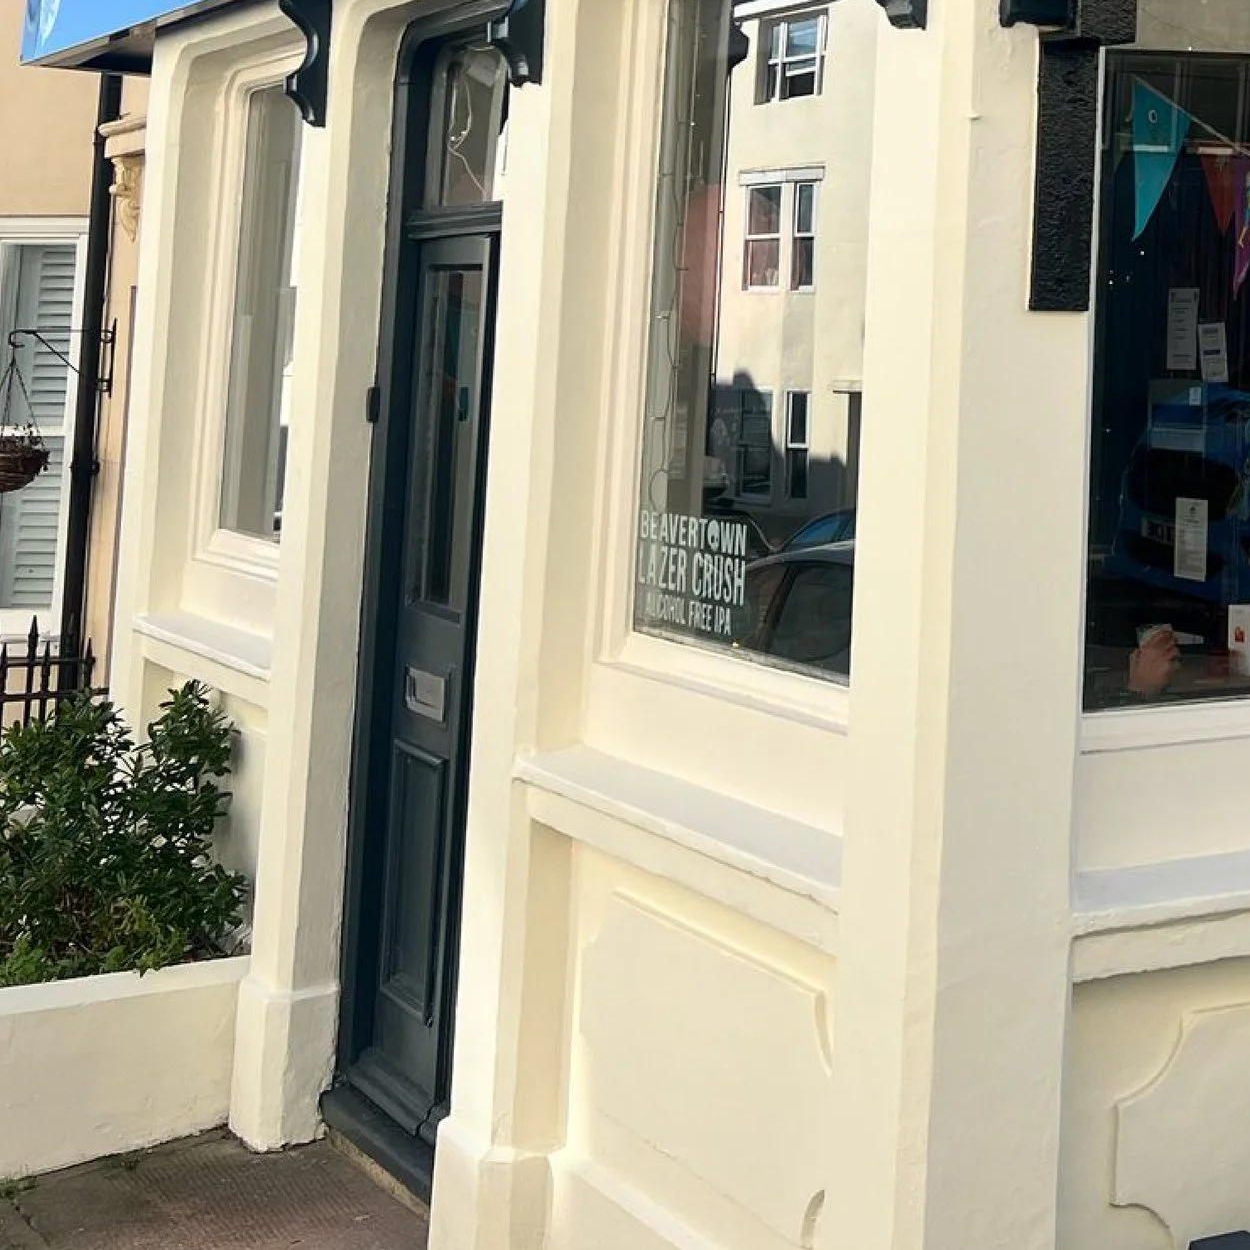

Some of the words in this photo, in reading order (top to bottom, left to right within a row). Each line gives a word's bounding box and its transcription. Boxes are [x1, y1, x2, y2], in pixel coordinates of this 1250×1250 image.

[639, 510, 747, 556] BEAVERTOWN
[638, 541, 687, 592] LAZER
[691, 552, 746, 606] CRUSH
[688, 601, 713, 631] FREE
[714, 606, 732, 636] IPA
